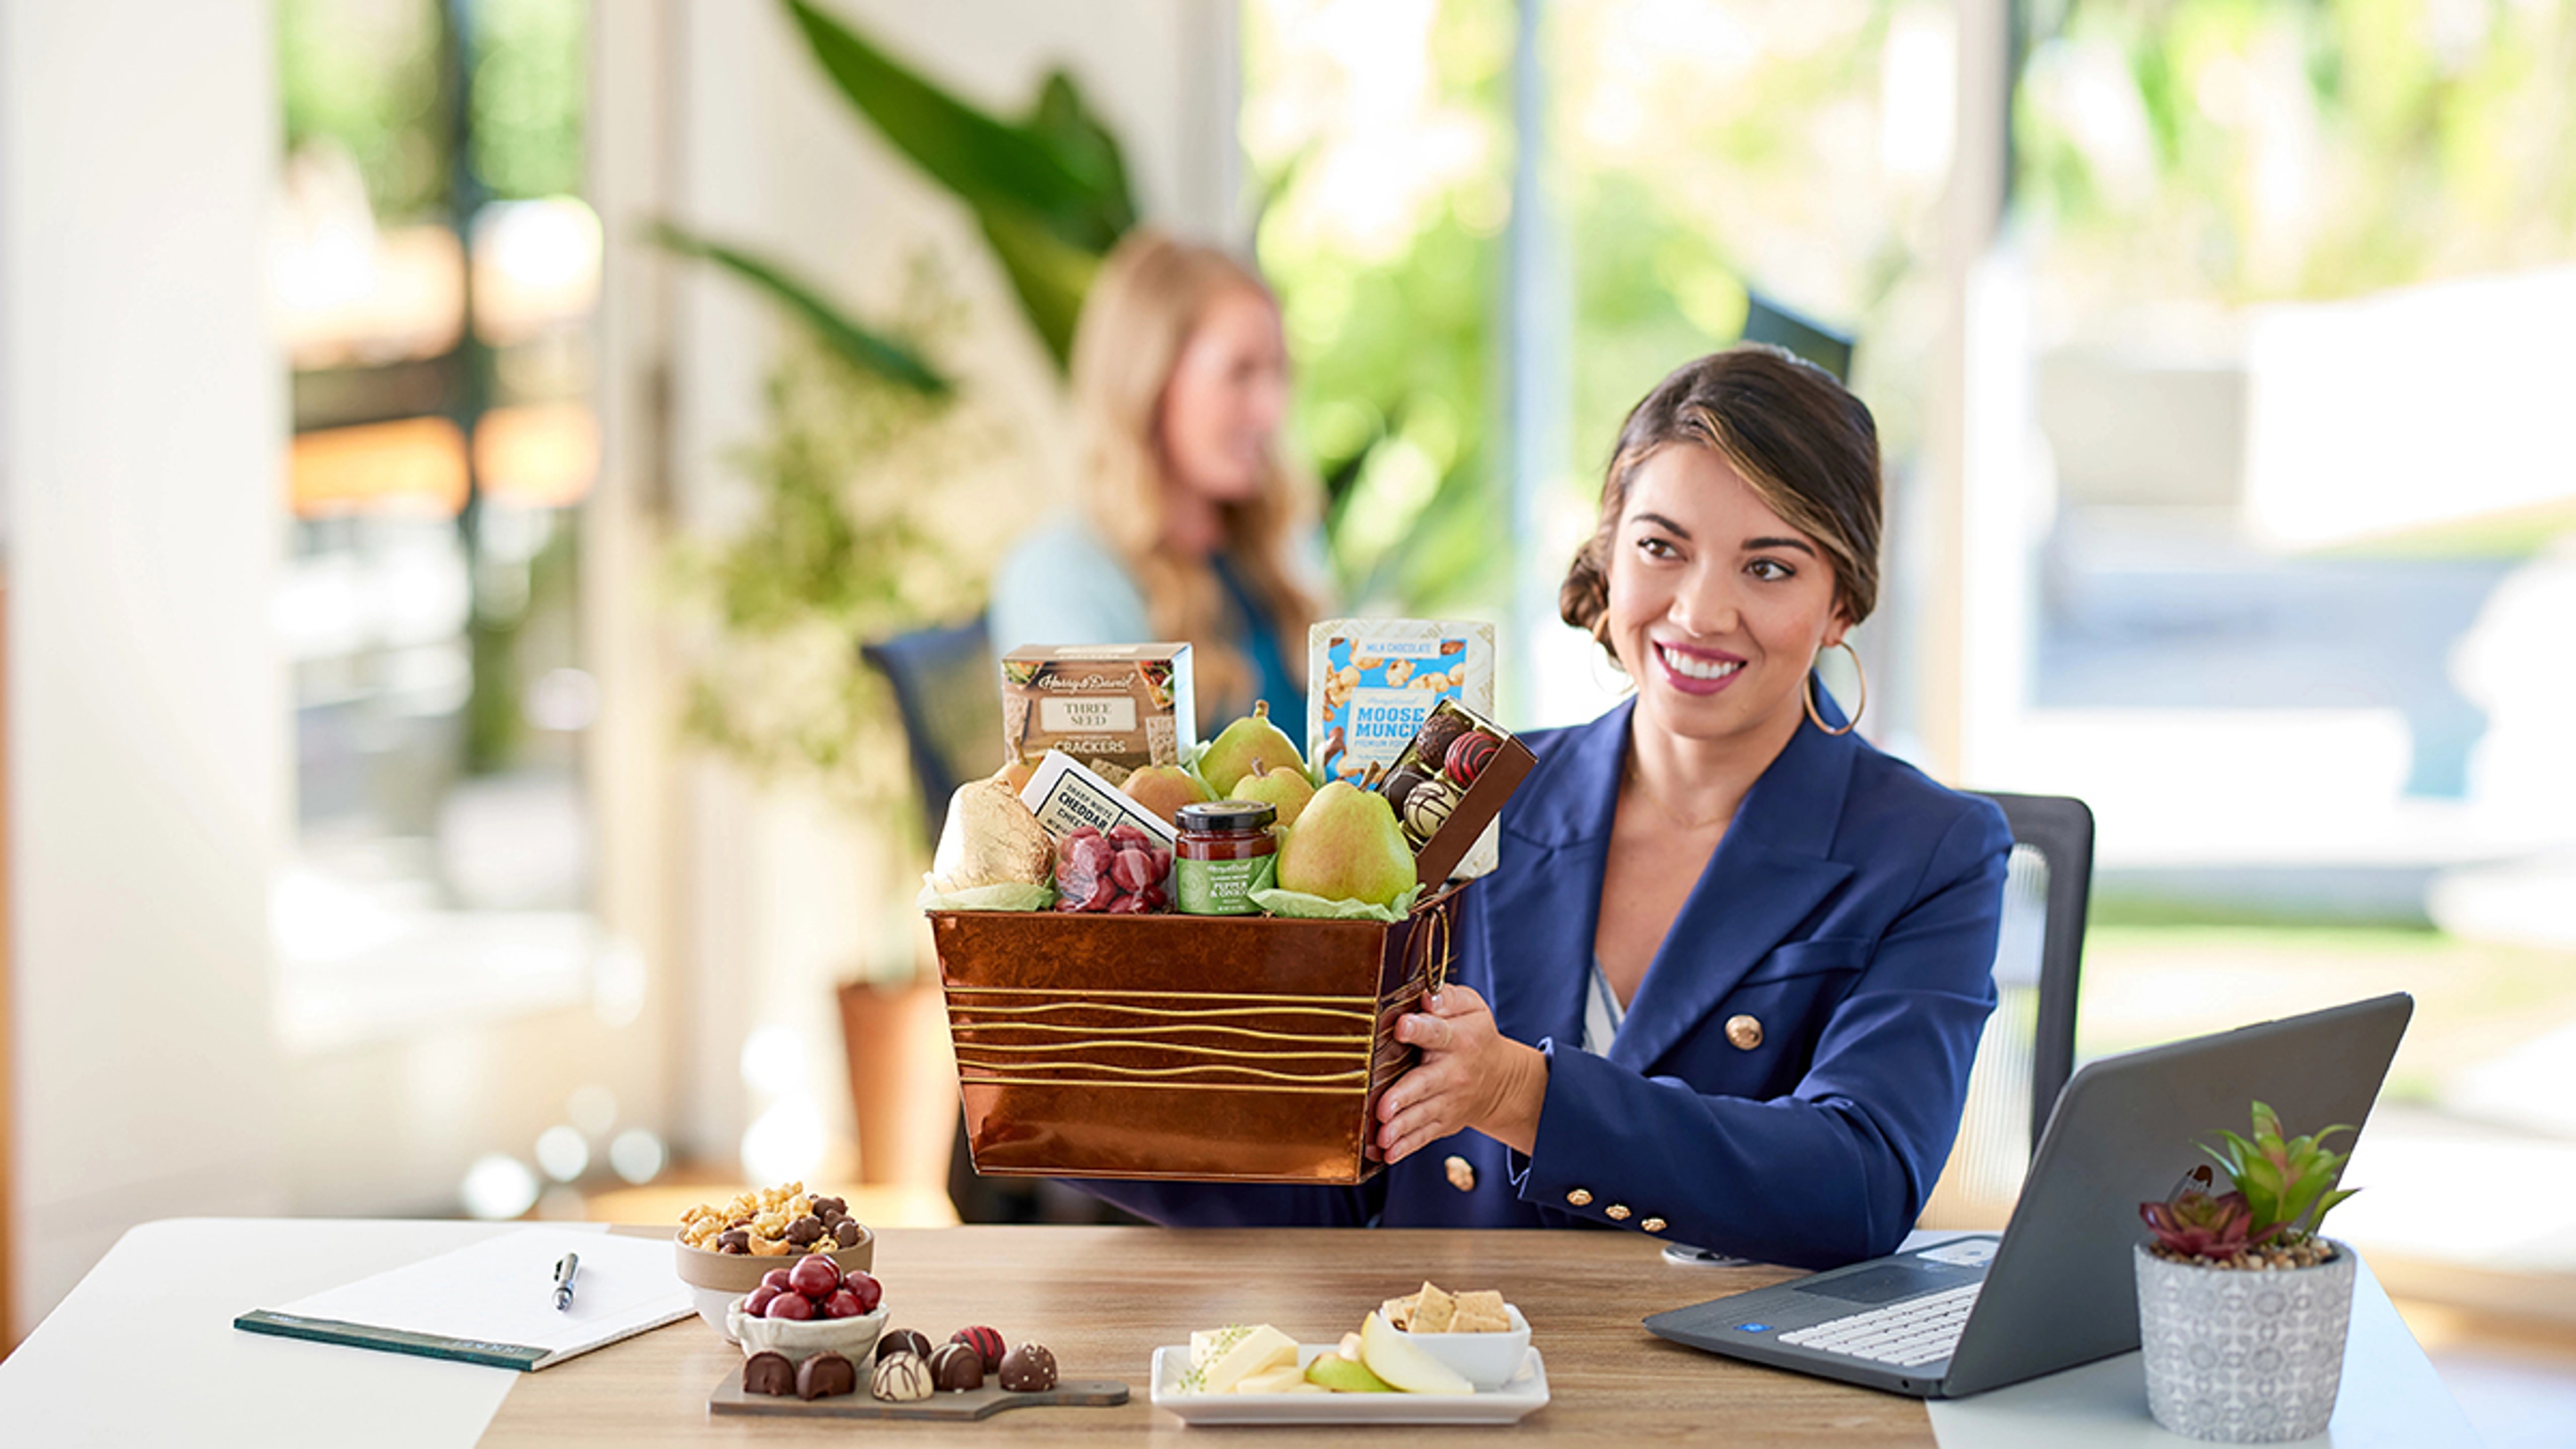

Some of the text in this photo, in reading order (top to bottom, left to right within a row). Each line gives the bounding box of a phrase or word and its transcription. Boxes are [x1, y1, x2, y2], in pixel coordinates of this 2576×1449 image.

[1365, 643, 1430, 653] MILK CHOCOLATE
[1063, 703, 1113, 714] THREE
[1356, 707, 1426, 722] MOOSE
[1069, 715, 1107, 726] SEED
[1355, 722, 1422, 738] MUNCH
[1053, 740, 1126, 754] CRACKERS
[1058, 792, 1108, 832] CHEDDAR
